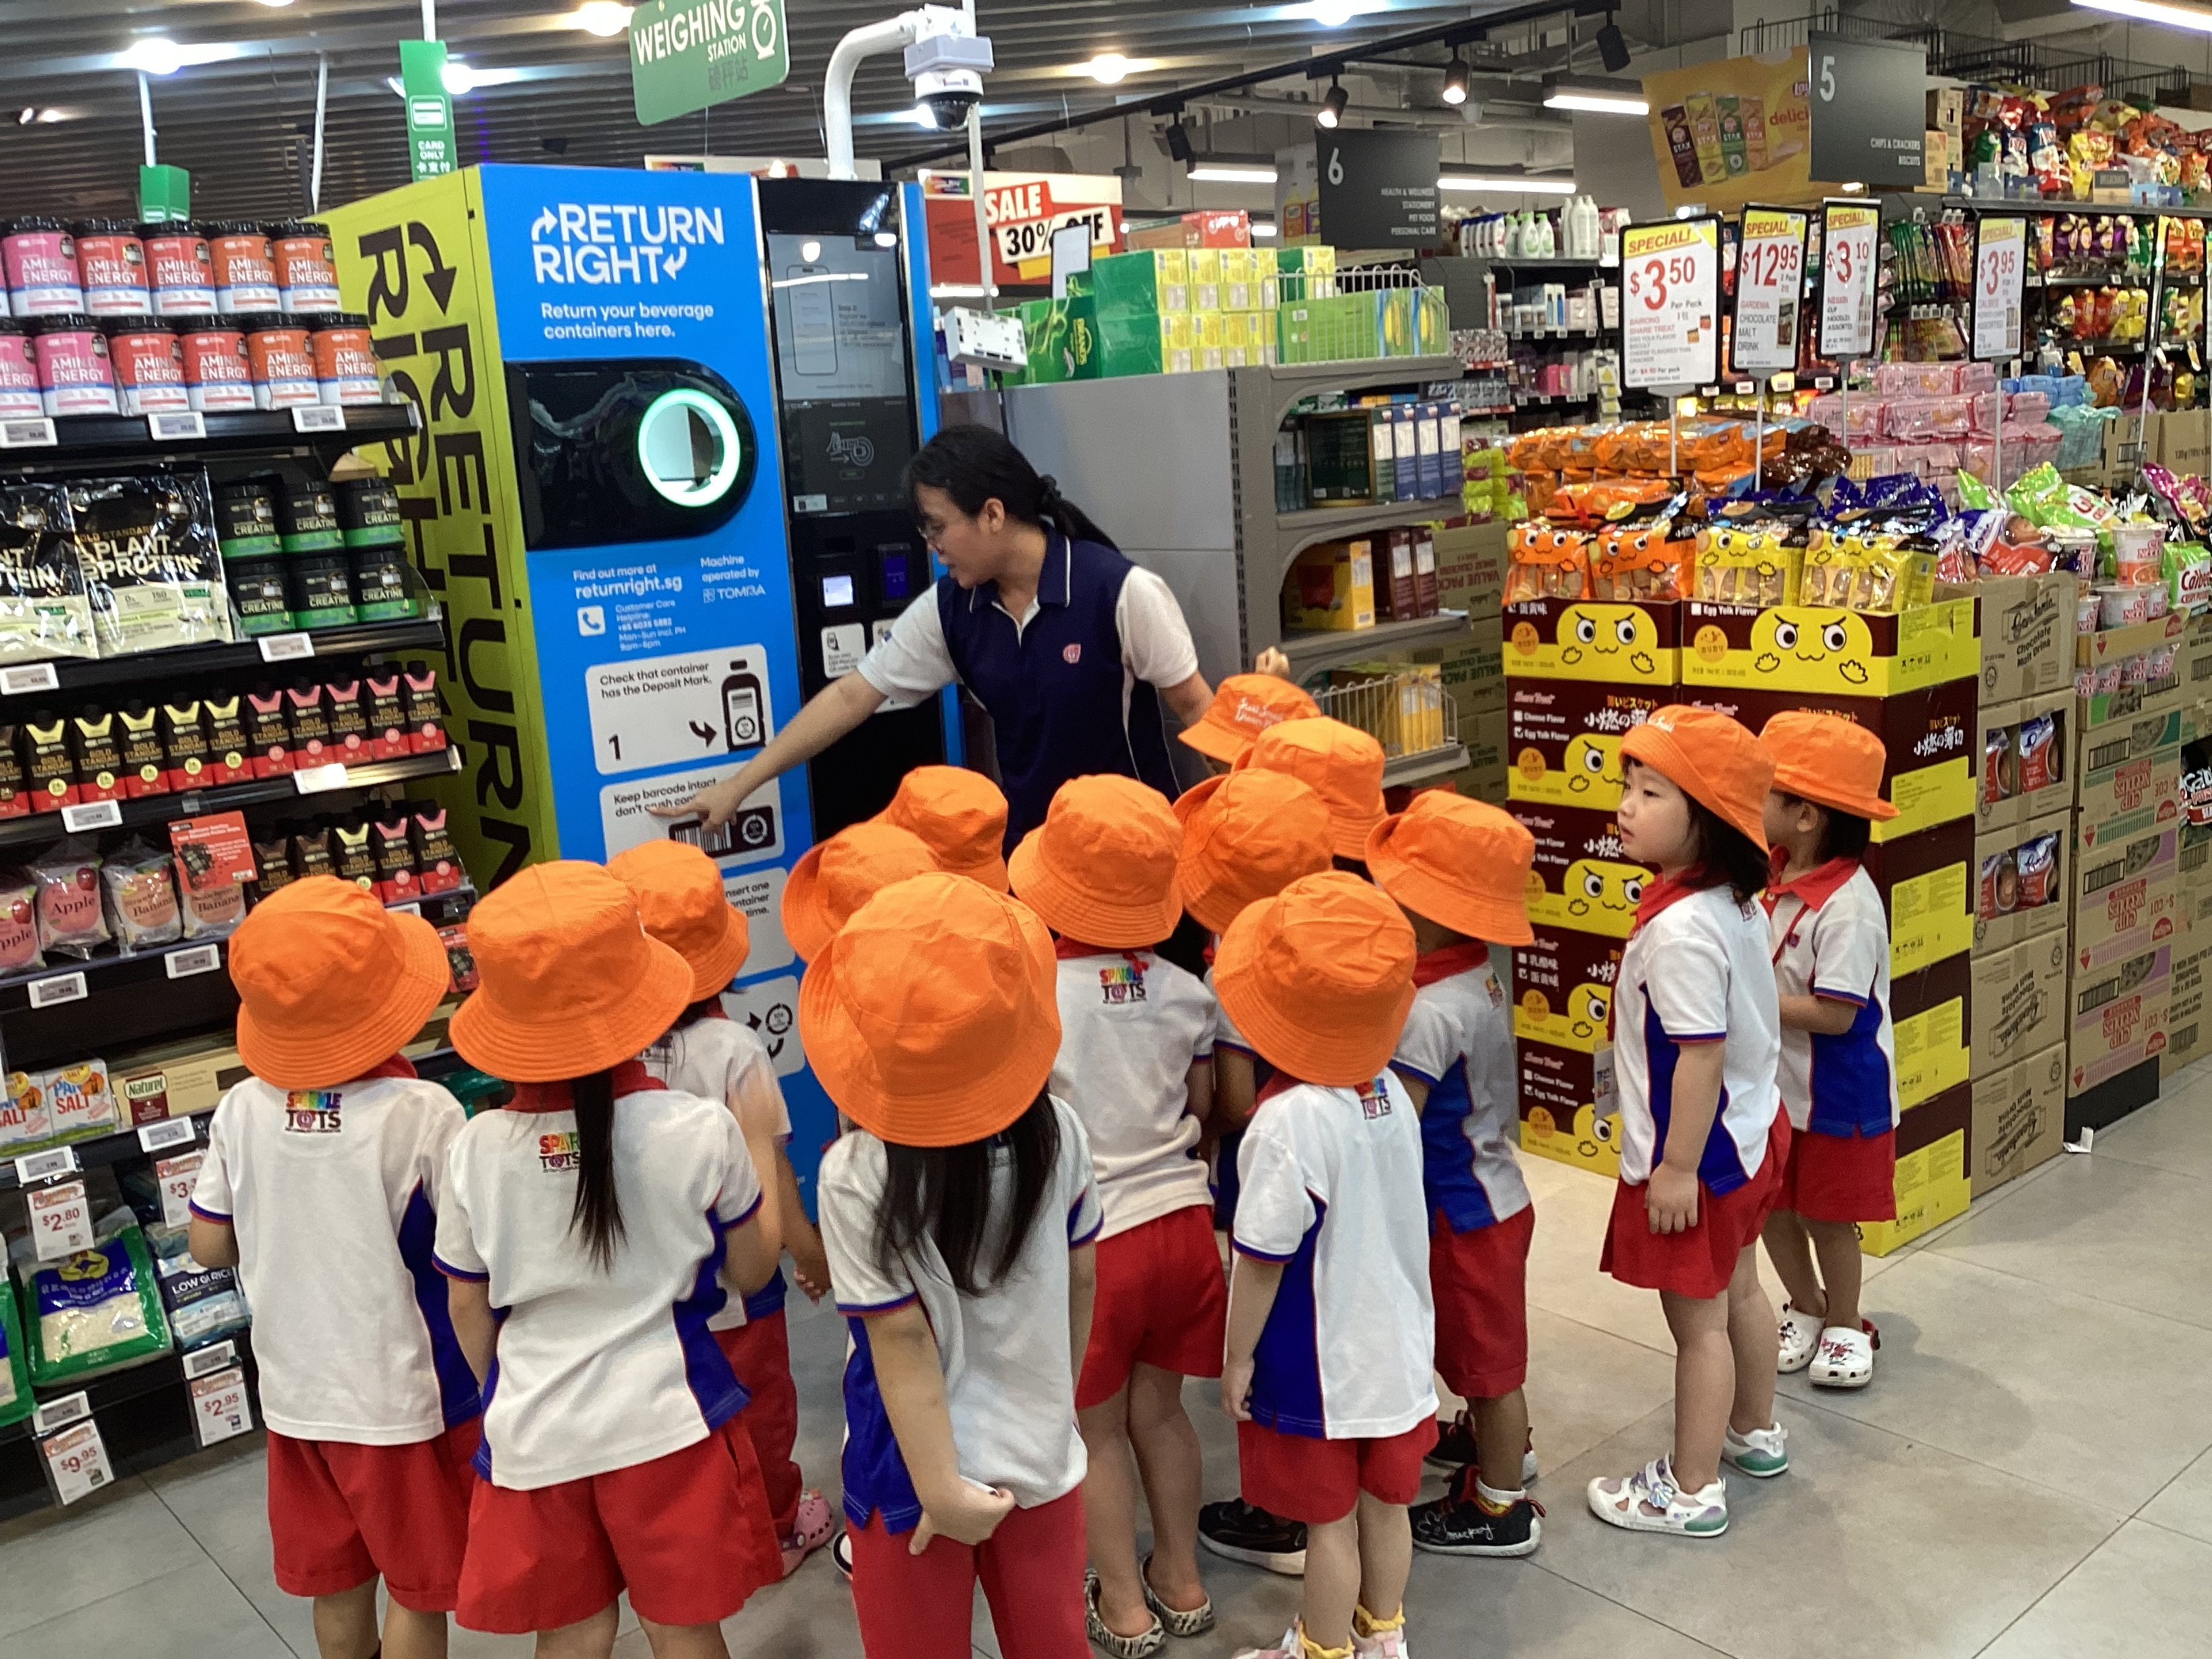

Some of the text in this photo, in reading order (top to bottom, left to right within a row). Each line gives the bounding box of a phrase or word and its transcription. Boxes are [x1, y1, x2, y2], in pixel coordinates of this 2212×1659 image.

[634, 0, 745, 66] WEIGHING
[708, 32, 747, 62] STATION
[1820, 56, 1835, 102] 5
[418, 141, 445, 150] CARD
[1723, 133, 1741, 142] STAX
[420, 151, 444, 160] ONLY
[1673, 142, 1692, 153] STAX
[1328, 147, 1344, 185] 6
[985, 184, 1042, 223] SALE
[558, 203, 724, 245] RETURN
[1746, 220, 1788, 235] SPECIAL!
[1629, 229, 1692, 254] SPECIAL!
[533, 245, 663, 284] RIGHT
[23, 270, 73, 283] ENERGY
[87, 271, 137, 285] ENERGY
[157, 271, 205, 285] ENERGY
[229, 270, 273, 283] ENERGY
[289, 272, 333, 284] ENERGY
[541, 302, 714, 321] Return your beverage
[1740, 314, 1777, 324] CHOCOLATE
[544, 321, 676, 339] containers here.
[1739, 327, 1756, 337] MALT
[1737, 342, 1759, 351] DRINK
[53, 369, 104, 382] ENERGY
[136, 369, 182, 382] ENERGY
[201, 367, 247, 380] ENERGY
[268, 365, 312, 377] ENERGY
[337, 363, 377, 376] ENERGY
[94, 534, 170, 561] PLANT
[98, 554, 202, 580] PROTEIN
[700, 554, 745, 568] Machine
[573, 564, 657, 581] Find out more at
[702, 567, 760, 583] operated by
[575, 575, 682, 599] returnright.sg
[717, 584, 766, 600] TOMRA
[1703, 604, 1758, 617] Egg Yolk Flavor
[2017, 626, 2051, 655] Chocolate
[2018, 638, 2051, 668] Malt Drink
[600, 662, 710, 687] Check that container
[601, 684, 621, 699] has
[623, 682, 640, 696] the
[642, 678, 682, 693] Deposit
[609, 733, 622, 762] 1
[613, 792, 641, 806] Keep
[642, 783, 687, 800] barcode
[615, 803, 643, 817] don't
[752, 881, 770, 894] one
[52, 895, 96, 918] Apple
[133, 896, 173, 917] Banana
[197, 894, 241, 913] Banana
[0, 930, 33, 951] pple
[128, 1078, 164, 1096] Naturel
[56, 1094, 91, 1115] SALT
[539, 1132, 581, 1154] SPAR
[171, 1277, 199, 1294] LOW
